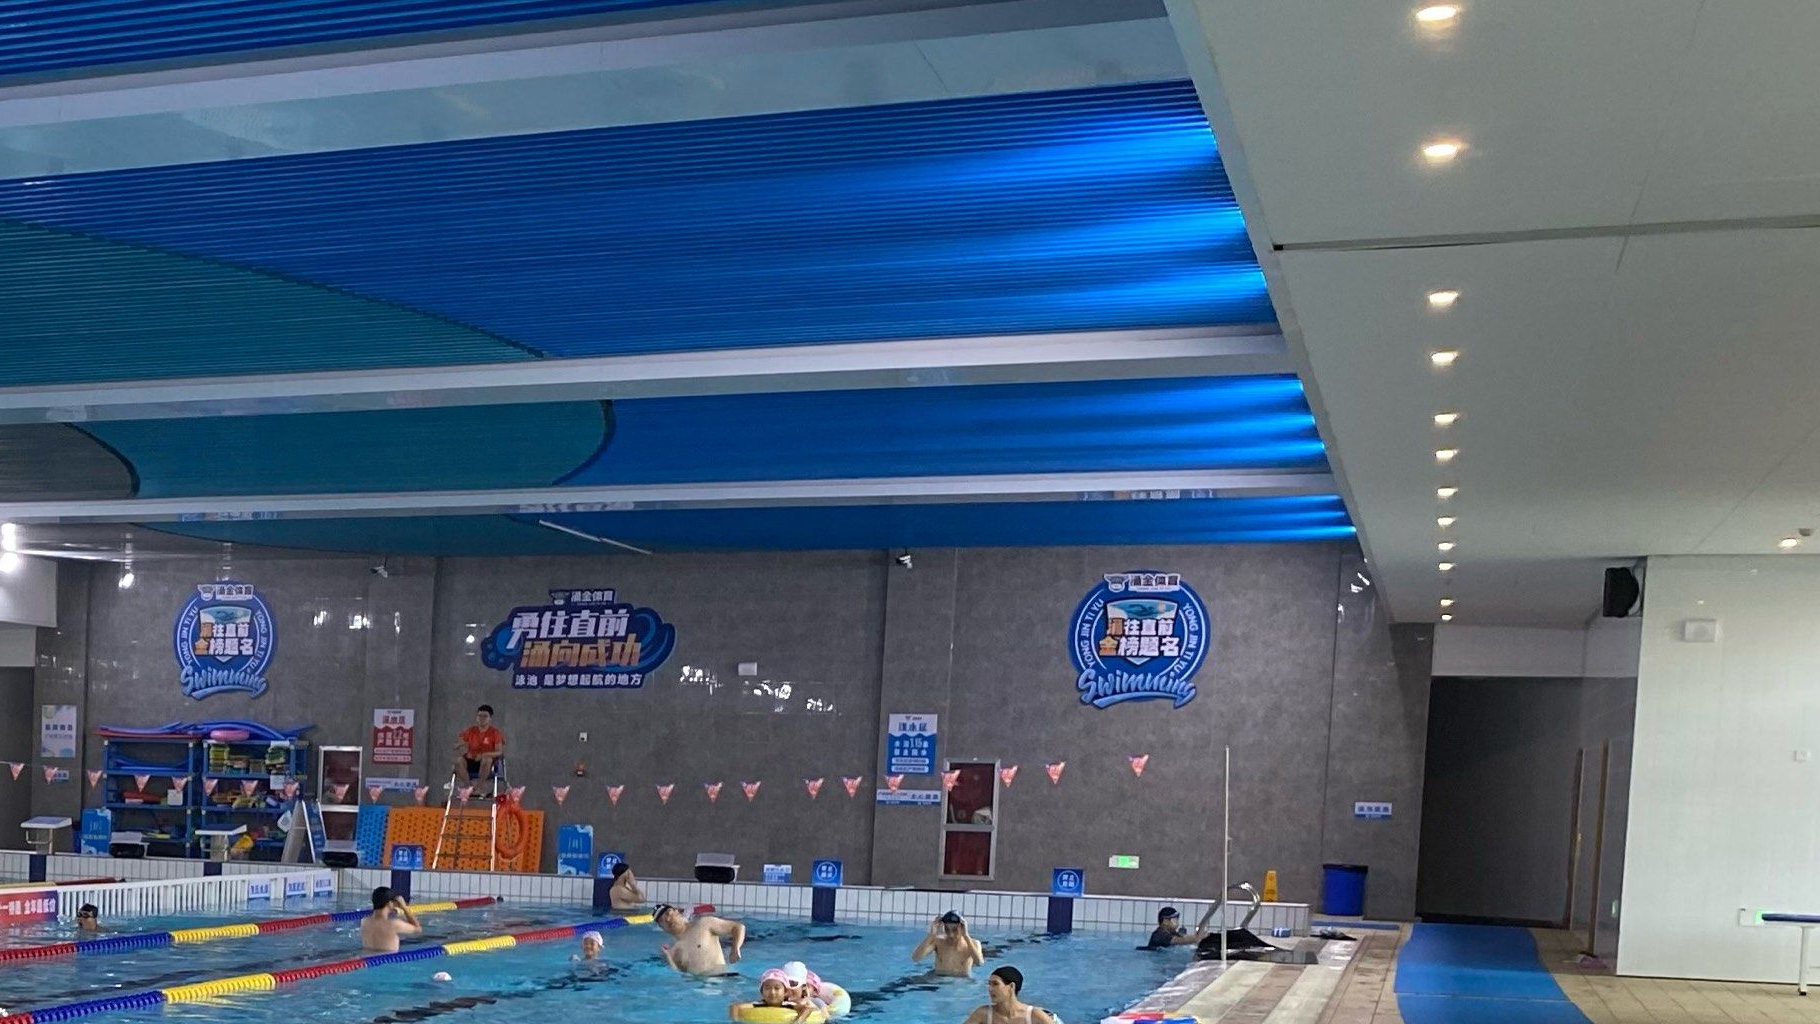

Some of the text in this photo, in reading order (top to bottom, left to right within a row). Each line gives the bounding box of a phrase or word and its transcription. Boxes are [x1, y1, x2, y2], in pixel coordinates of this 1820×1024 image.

[195, 638, 254, 656] 金榜题名
[520, 633, 642, 668] 涌向成功
[1099, 636, 1180, 657] 金榜题名
[180, 664, 269, 700] Swimming
[515, 673, 643, 687] 泳池 是梦想起航的地方
[1078, 668, 1197, 710] Swimming
